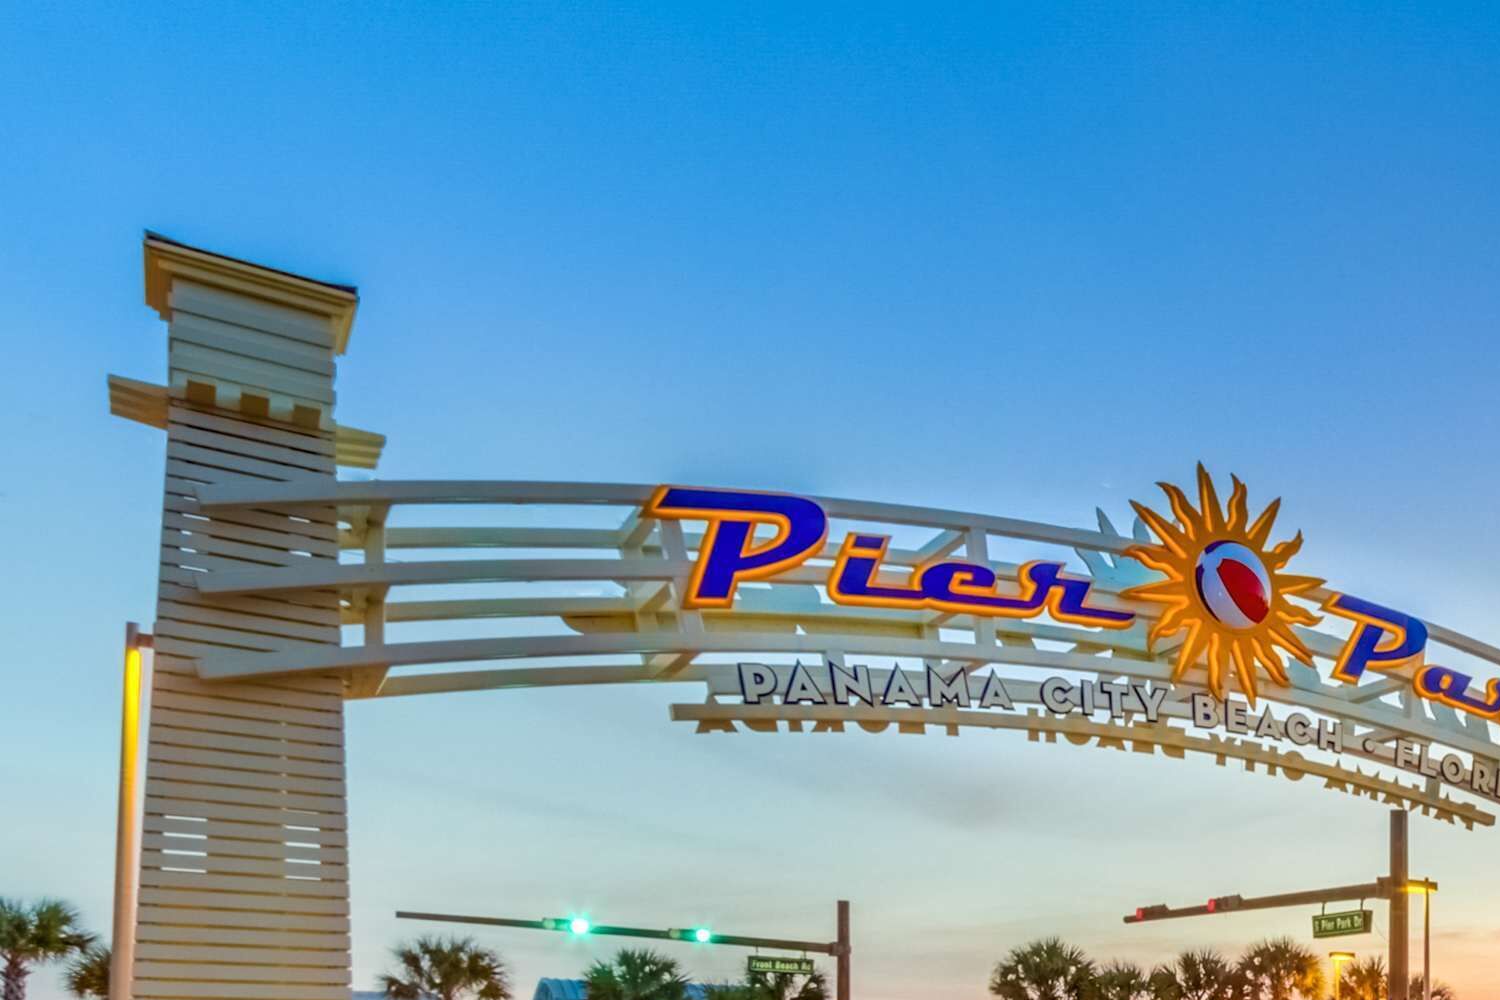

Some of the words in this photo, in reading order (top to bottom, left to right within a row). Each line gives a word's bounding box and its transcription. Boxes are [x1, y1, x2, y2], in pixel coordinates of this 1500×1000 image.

[645, 484, 1135, 629] Pier
[736, 659, 1016, 710] PANAMA
[1040, 675, 1168, 723] CITY
[1192, 694, 1344, 753] BEACH
[1321, 919, 1335, 931] Pier
[1336, 917, 1352, 930] Park
[752, 959, 772, 969] Front
[775, 960, 799, 970] Beach
